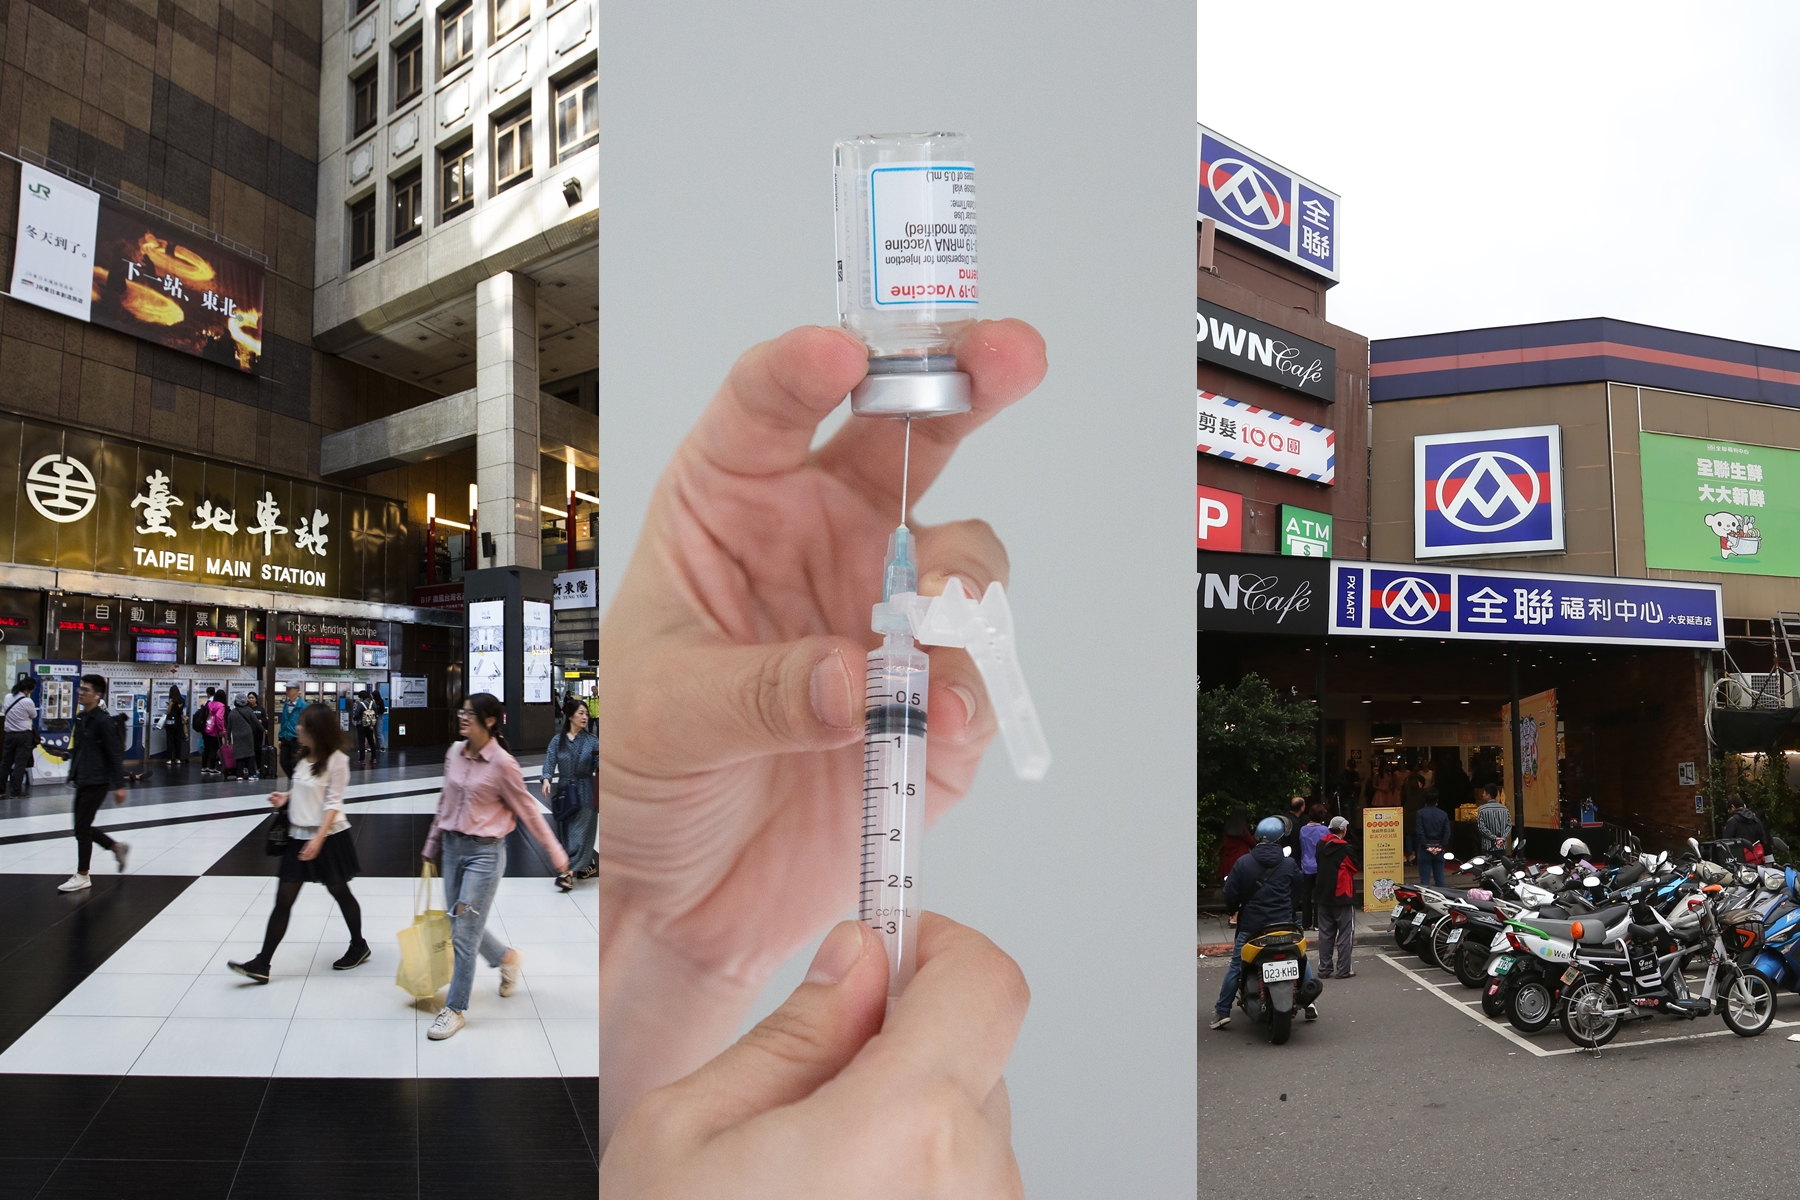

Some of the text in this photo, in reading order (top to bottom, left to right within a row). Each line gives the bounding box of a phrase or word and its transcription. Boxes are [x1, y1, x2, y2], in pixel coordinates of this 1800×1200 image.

[926, 170, 942, 182] mL)
[944, 171, 956, 181] 0.5
[957, 172, 963, 181] of
[28, 183, 51, 199] JR
[952, 184, 963, 194] vial
[954, 211, 965, 220] Use
[905, 222, 957, 237] modified)
[1302, 199, 1330, 260] 全聯
[885, 239, 932, 252] Vaccine
[935, 239, 965, 251] mRNA
[885, 254, 921, 266] Injection
[924, 255, 934, 264] for
[937, 253, 969, 264] Dispersion
[891, 285, 955, 299] Vaccine
[1271, 340, 1323, 387] Café
[1698, 484, 1765, 507] 大大新鮮
[131, 469, 330, 556] 臺北車站
[1198, 497, 1229, 540] P
[1285, 517, 1330, 541] ATM
[133, 547, 326, 587] TAIPEI MAIN STATION
[1237, 573, 1312, 624] Café
[1347, 575, 1356, 621] PX MART
[1466, 586, 1713, 627] 全聯 福利中心 大安延吉店
[95, 604, 238, 628] 自動售票機
[287, 621, 377, 636] Tickets Vending Machine
[895, 690, 921, 706] 0.5
[893, 736, 902, 749] 1
[891, 782, 916, 796] 1.5
[889, 829, 901, 842] 2
[887, 875, 913, 889] 2.5
[875, 907, 911, 918] cc/mL
[885, 922, 897, 935] 3
